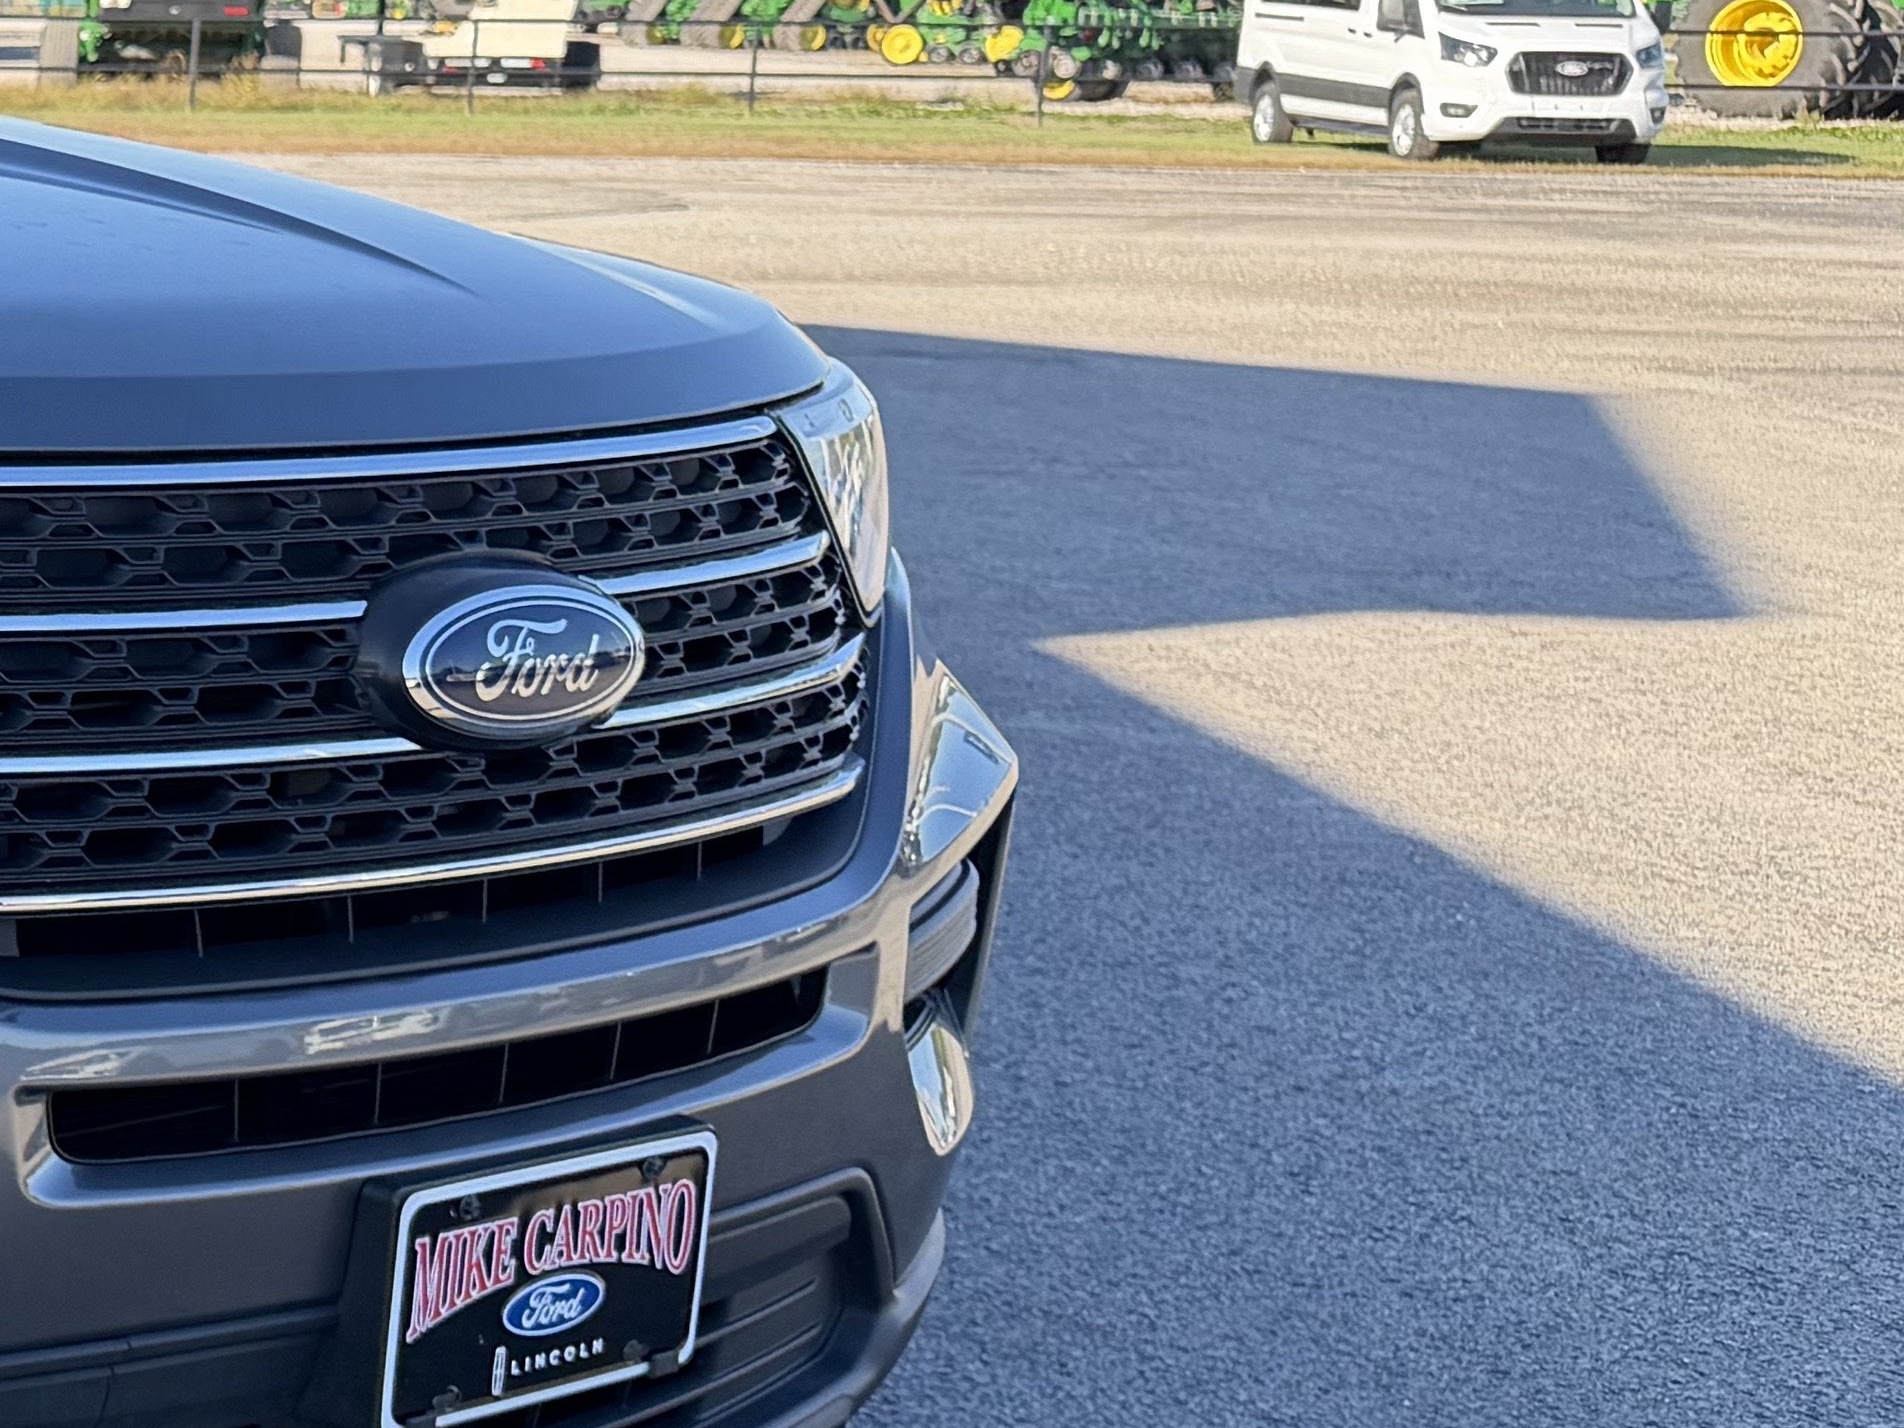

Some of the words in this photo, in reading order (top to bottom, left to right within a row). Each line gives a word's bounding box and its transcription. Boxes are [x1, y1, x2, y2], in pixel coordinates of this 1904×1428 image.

[475, 618, 600, 702] Ford
[405, 1216, 519, 1344] MIKE
[523, 1178, 697, 1277] CARPINO
[521, 1283, 586, 1329] Ford
[509, 1337, 605, 1376] LINCOLN
